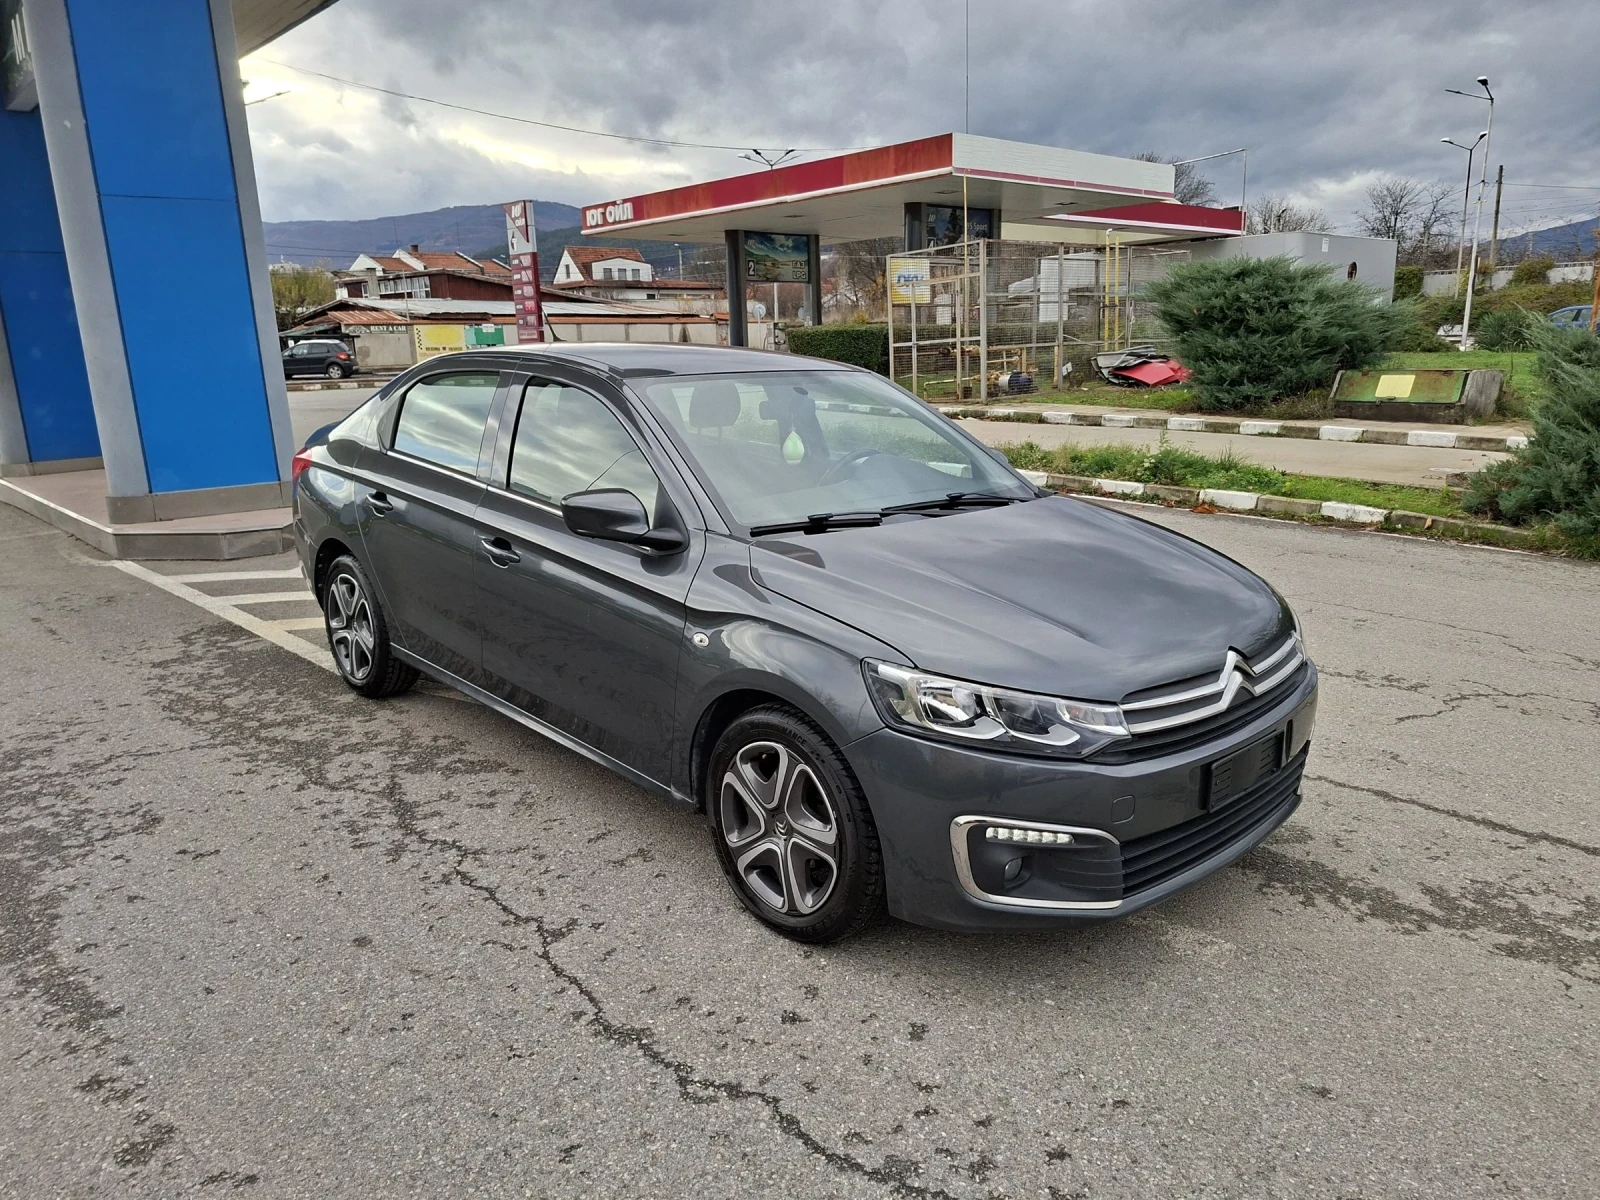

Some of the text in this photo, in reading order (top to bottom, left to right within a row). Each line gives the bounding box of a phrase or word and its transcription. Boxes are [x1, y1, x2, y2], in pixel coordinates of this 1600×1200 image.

[586, 200, 634, 227] ЮГ ОЙЛ
[973, 222, 988, 231] Sport
[748, 261, 755, 275] 2
[792, 271, 807, 279] LPG
